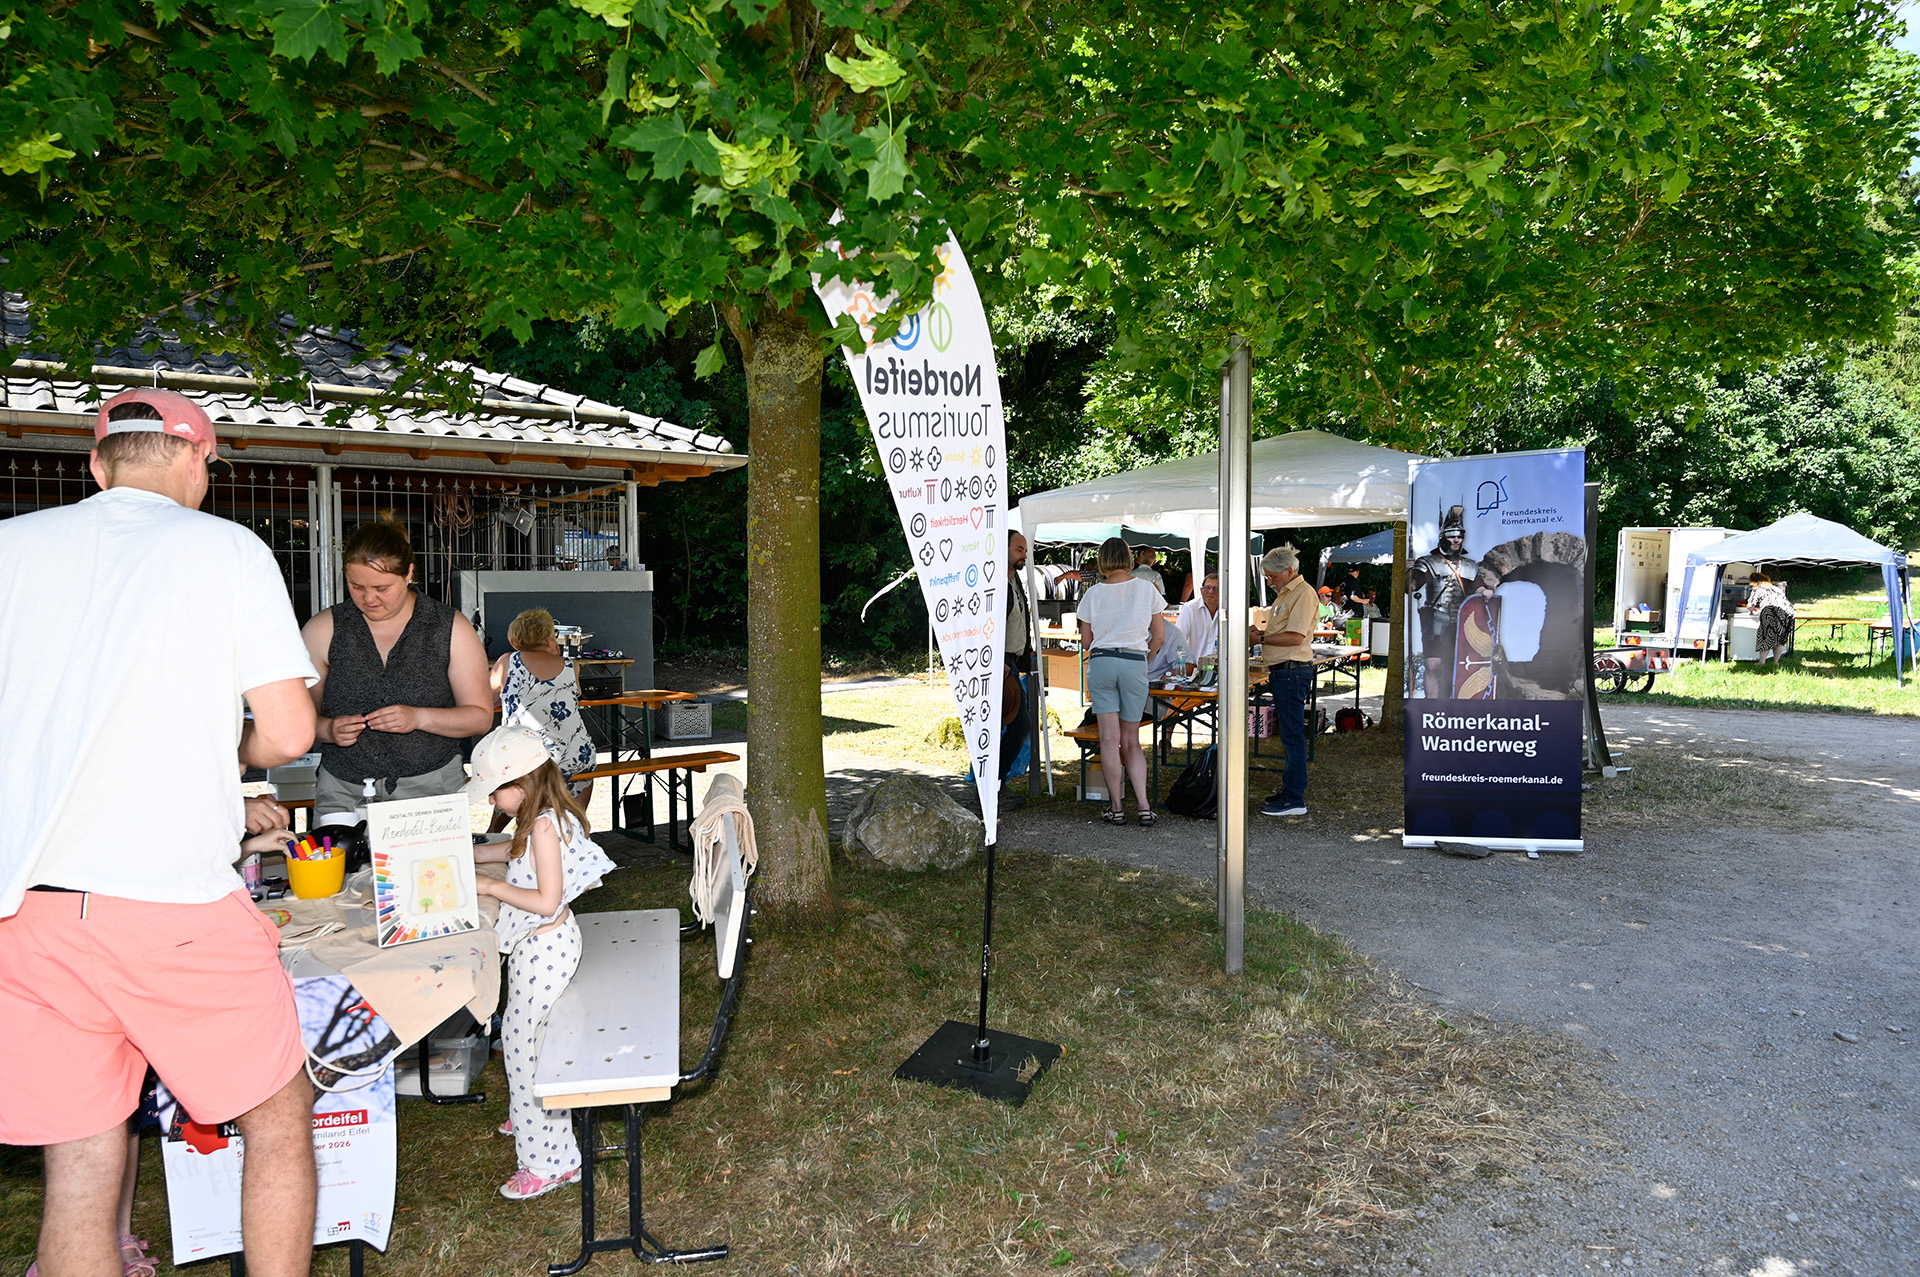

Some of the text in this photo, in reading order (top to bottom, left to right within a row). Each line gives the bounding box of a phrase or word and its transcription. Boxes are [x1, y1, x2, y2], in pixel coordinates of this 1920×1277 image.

[1501, 507, 1557, 517] Freundeskreis
[1501, 515, 1564, 525] Römerkanal e.V.
[1422, 711, 1550, 731] Römerkanal-
[1421, 735, 1538, 758] Wanderweg
[1421, 772, 1564, 785] freundeskreis-roemerkanal.de
[312, 1112, 363, 1127] ordeifel
[348, 1127, 370, 1136] Eifel
[328, 1140, 351, 1149] 2026
